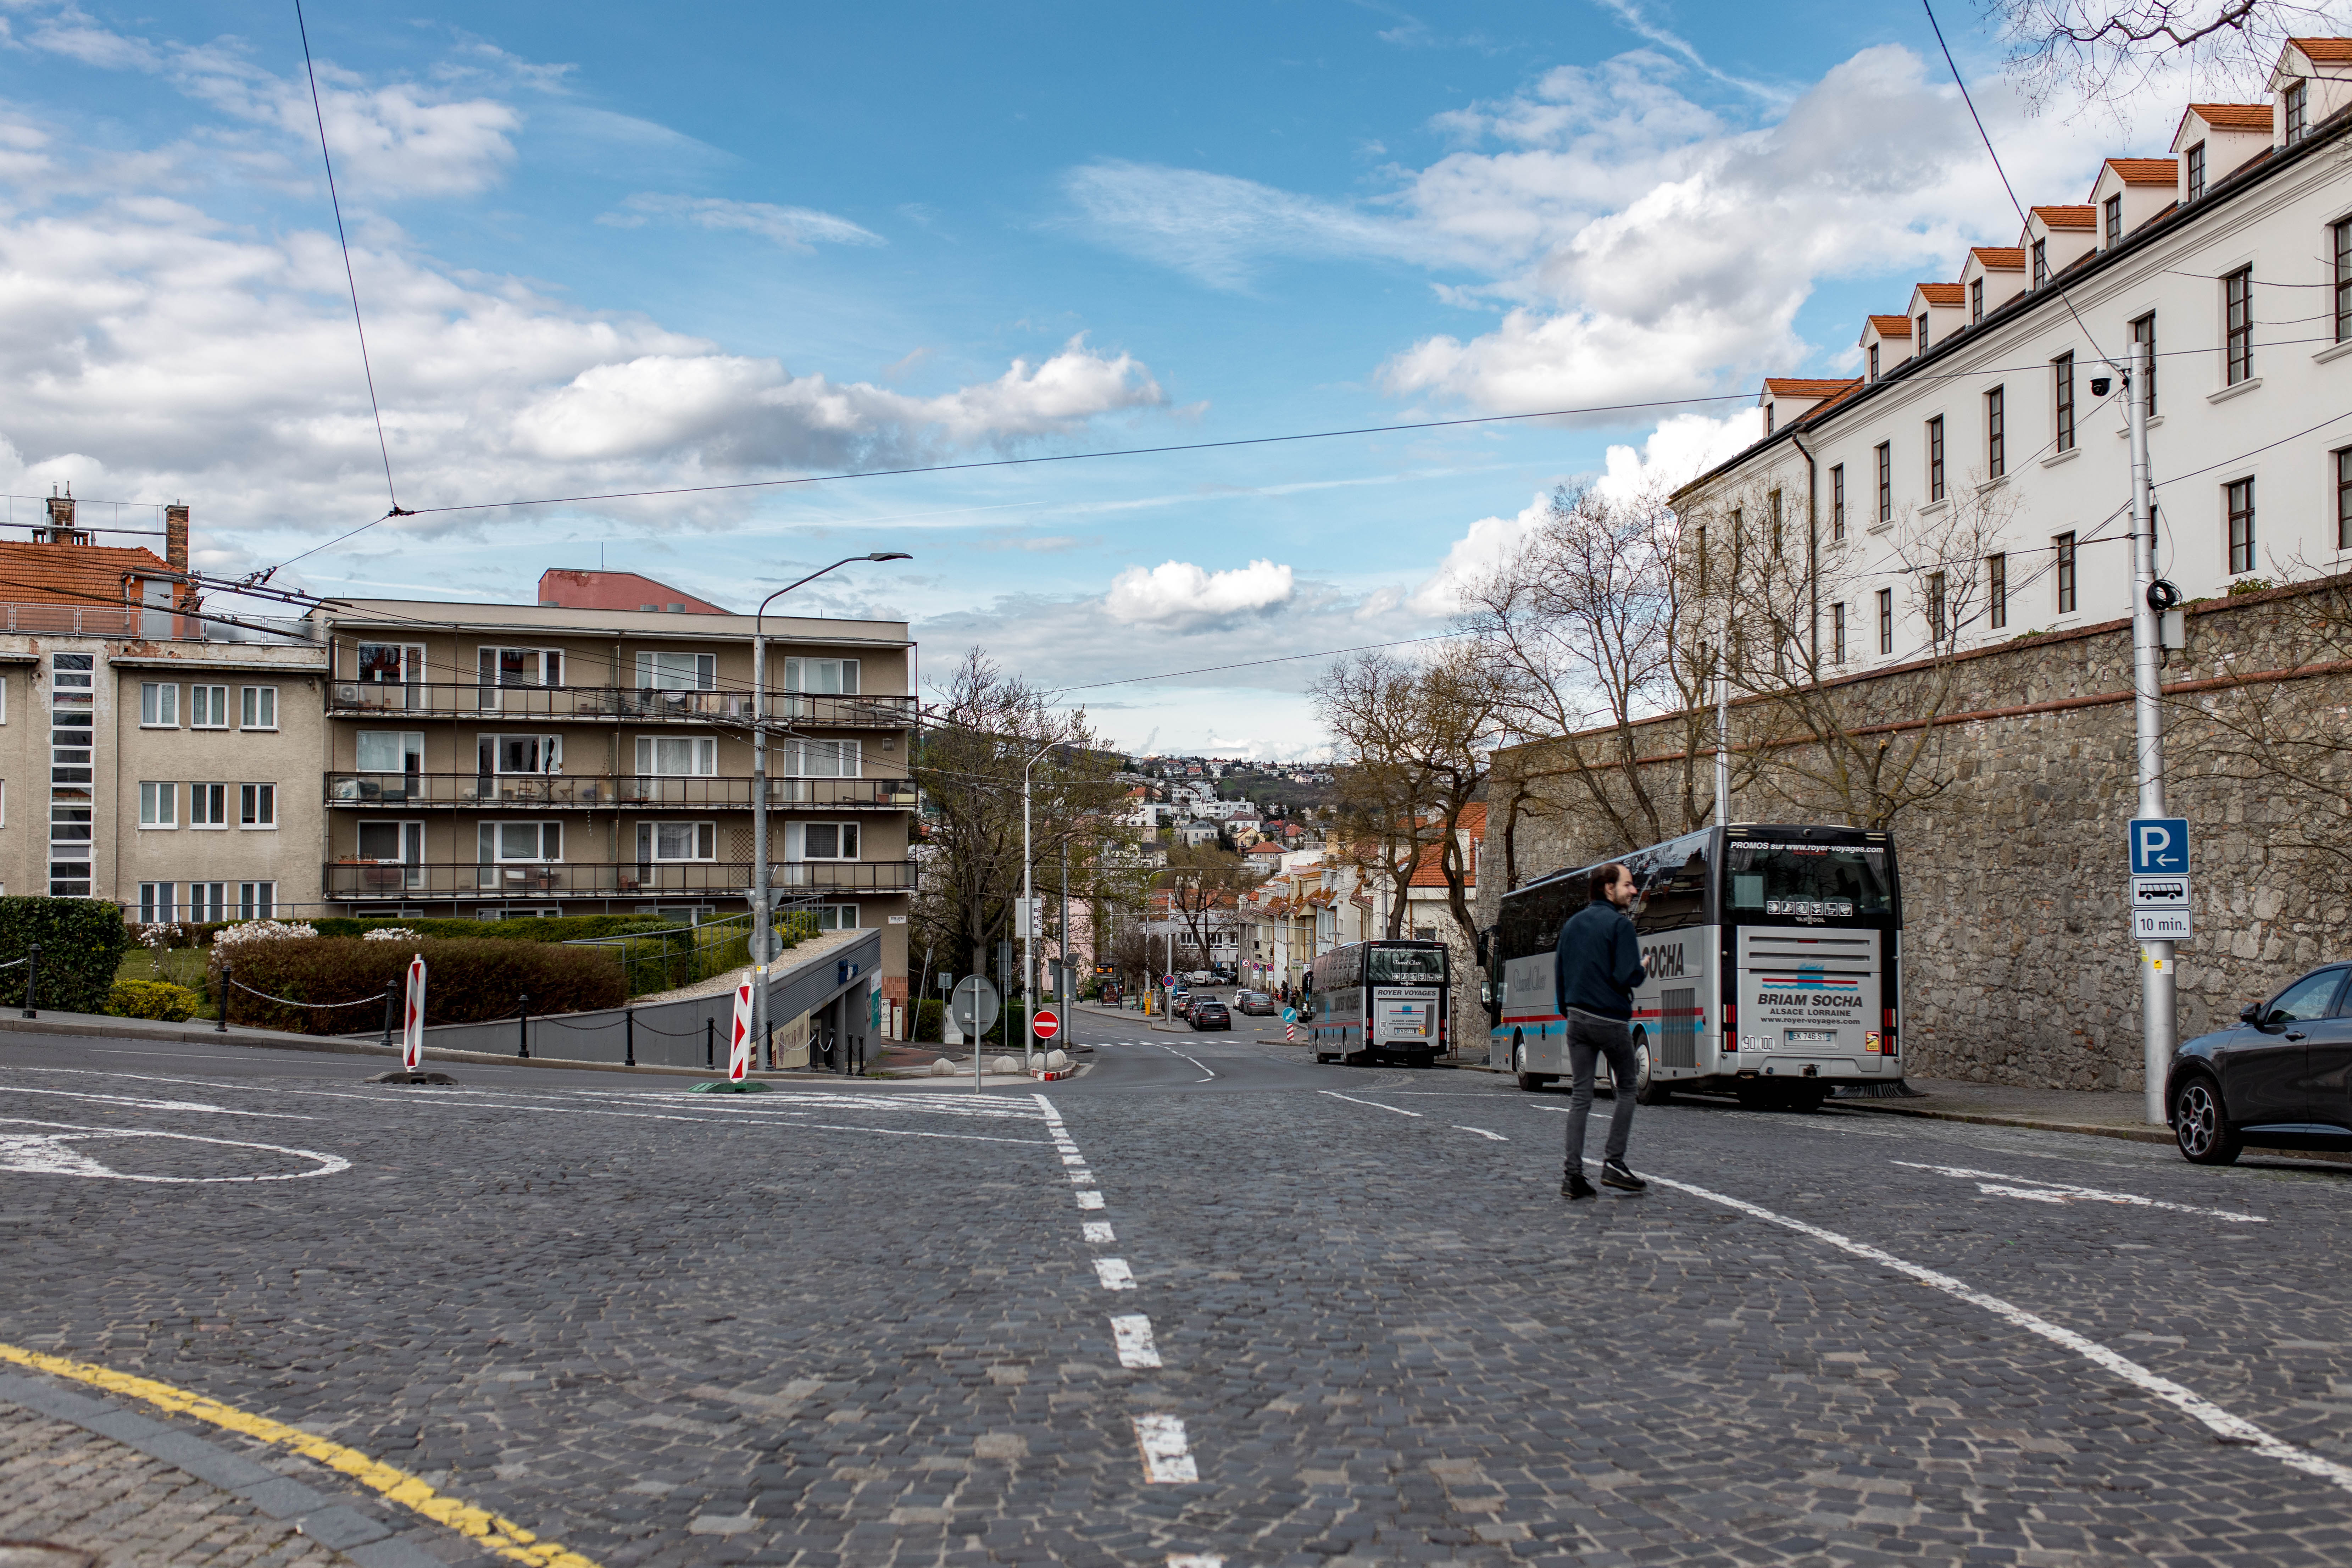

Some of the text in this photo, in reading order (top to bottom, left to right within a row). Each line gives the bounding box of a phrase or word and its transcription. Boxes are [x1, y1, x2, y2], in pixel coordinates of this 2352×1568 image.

[1786, 845, 1884, 853] www.royer-voyages.com
[2140, 827, 2170, 867] P
[2140, 917, 2186, 930] 10 min.
[1758, 994, 1863, 1007] BRIAM SOCHA
[1744, 1036, 1755, 1049] 90
[1761, 1038, 1773, 1050] 100
